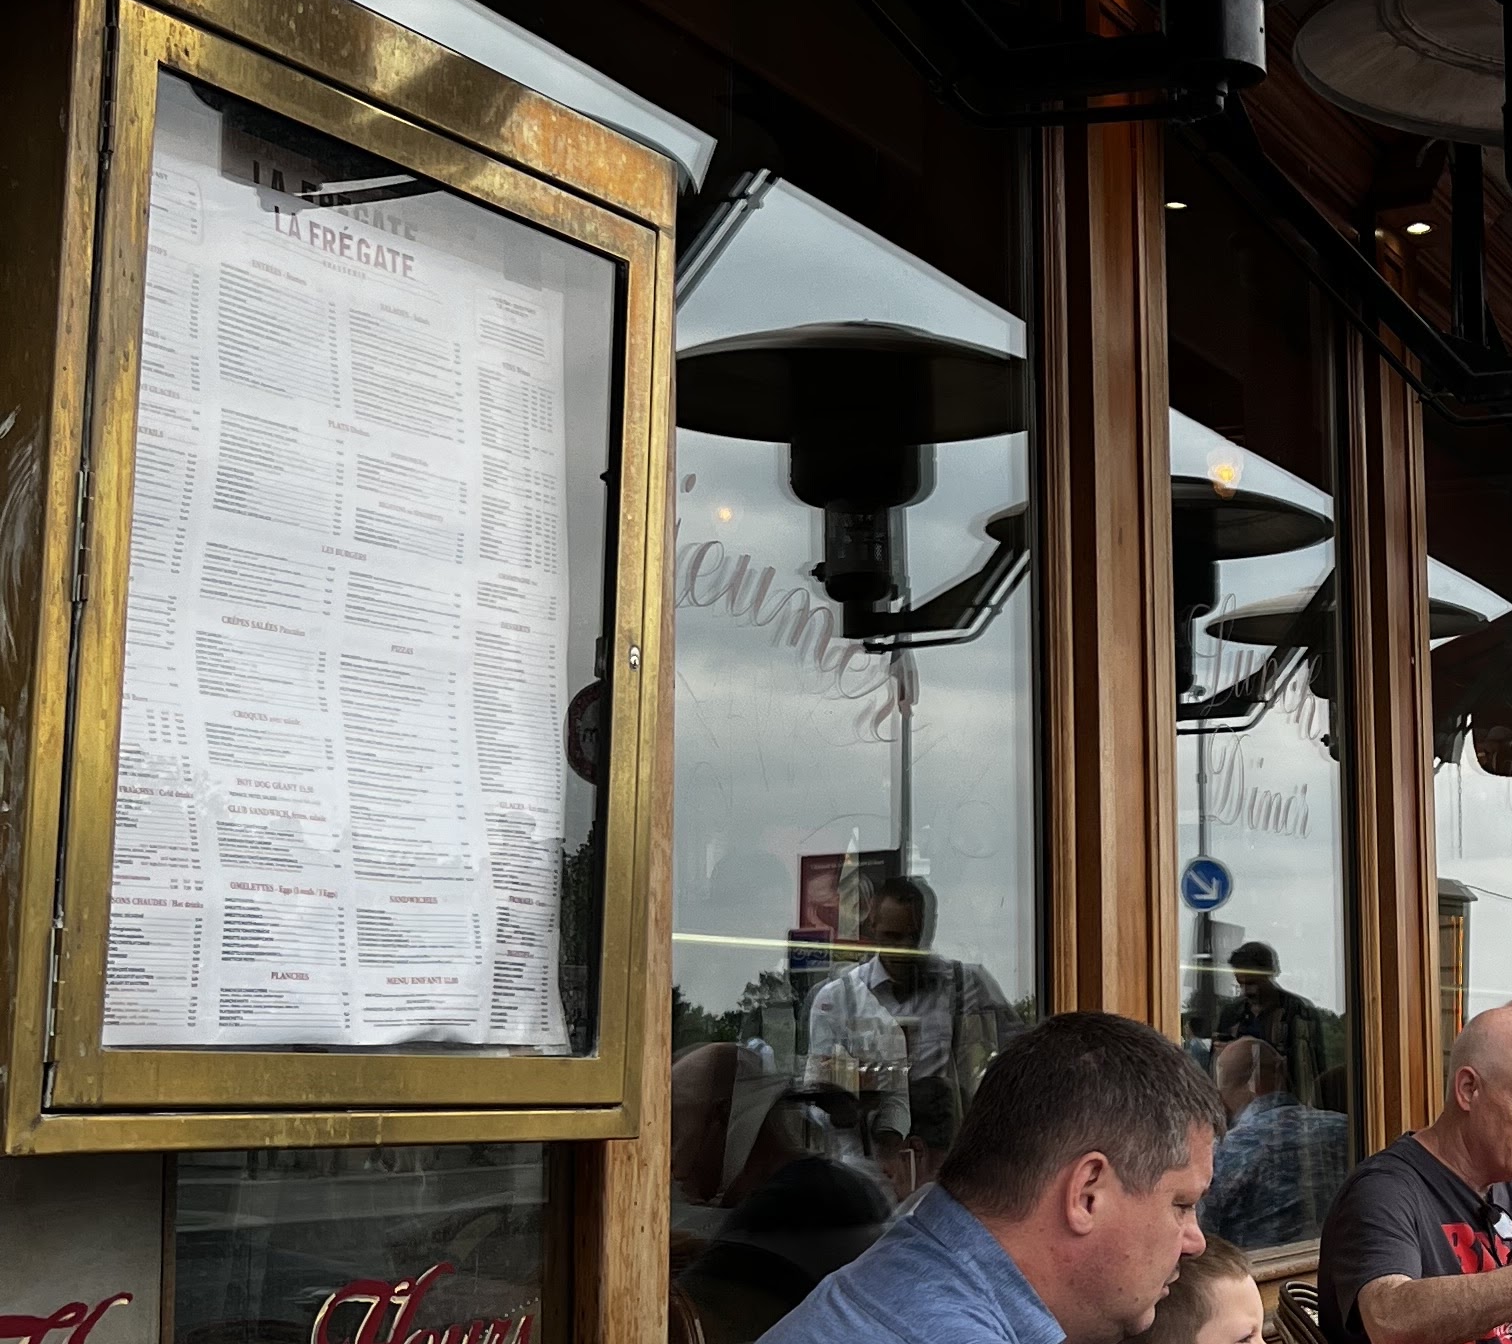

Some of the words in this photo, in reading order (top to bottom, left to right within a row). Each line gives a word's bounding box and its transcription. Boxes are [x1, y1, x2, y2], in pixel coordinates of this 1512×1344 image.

[274, 206, 302, 241] LA
[309, 220, 416, 280] FRÉGATE
[390, 644, 414, 655] PIZZAS
[230, 881, 274, 893] OMELETTES
[131, 898, 167, 908] CHAUDES
[270, 971, 309, 981] PLANCHES
[410, 976, 442, 985] ENFANT
